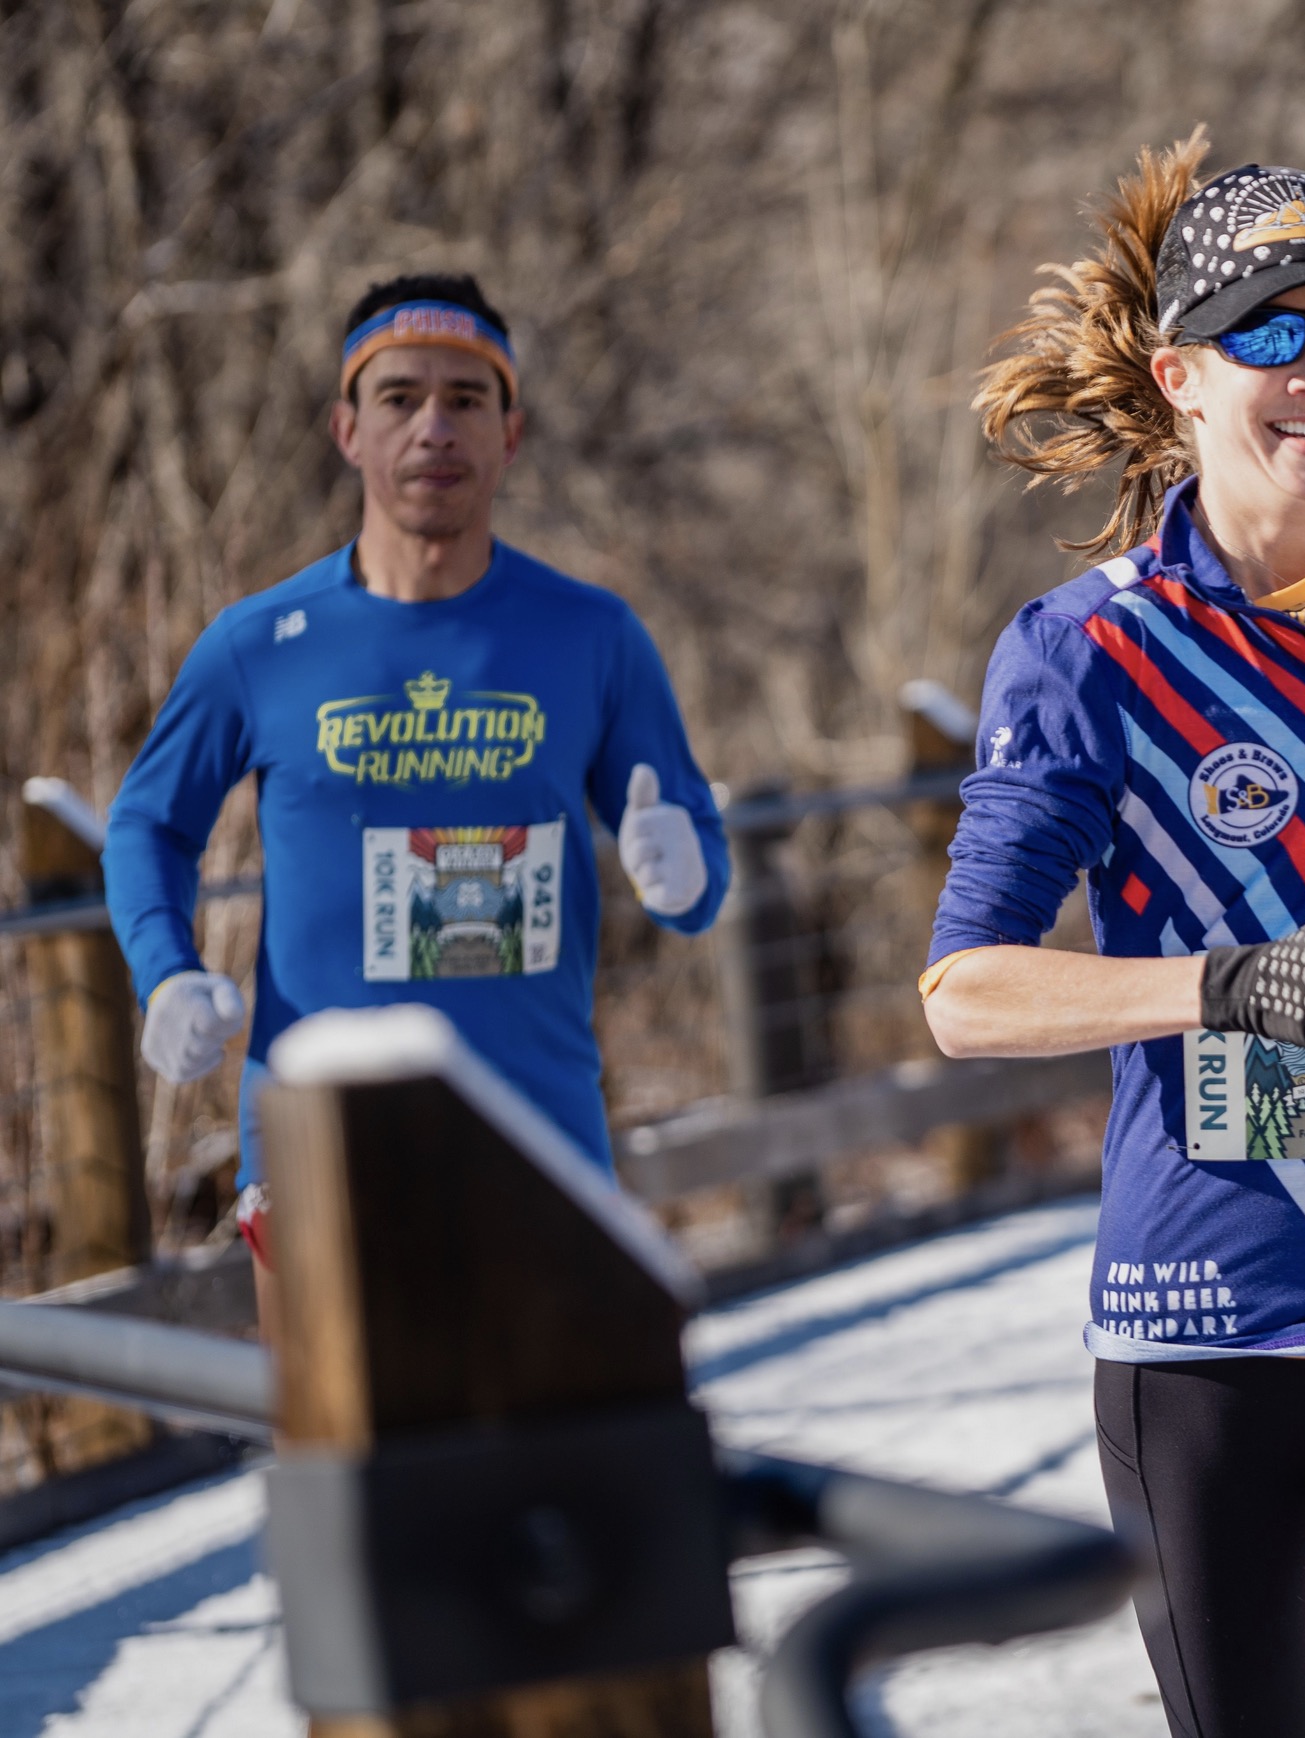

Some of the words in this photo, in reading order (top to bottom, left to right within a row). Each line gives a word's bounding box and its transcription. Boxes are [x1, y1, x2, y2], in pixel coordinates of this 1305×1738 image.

[317, 709, 545, 752] REVOLUTION
[356, 748, 514, 785] RUNNING
[1199, 753, 1234, 782] Shoes
[1238, 748, 1247, 759] &
[374, 849, 395, 896] 10K
[531, 862, 554, 929] 942
[374, 902, 395, 958] RUN
[1198, 1054, 1228, 1130] RUN
[1107, 1262, 1145, 1285] RUN
[1153, 1260, 1222, 1284] WILD.
[1166, 1287, 1237, 1311] BEER.
